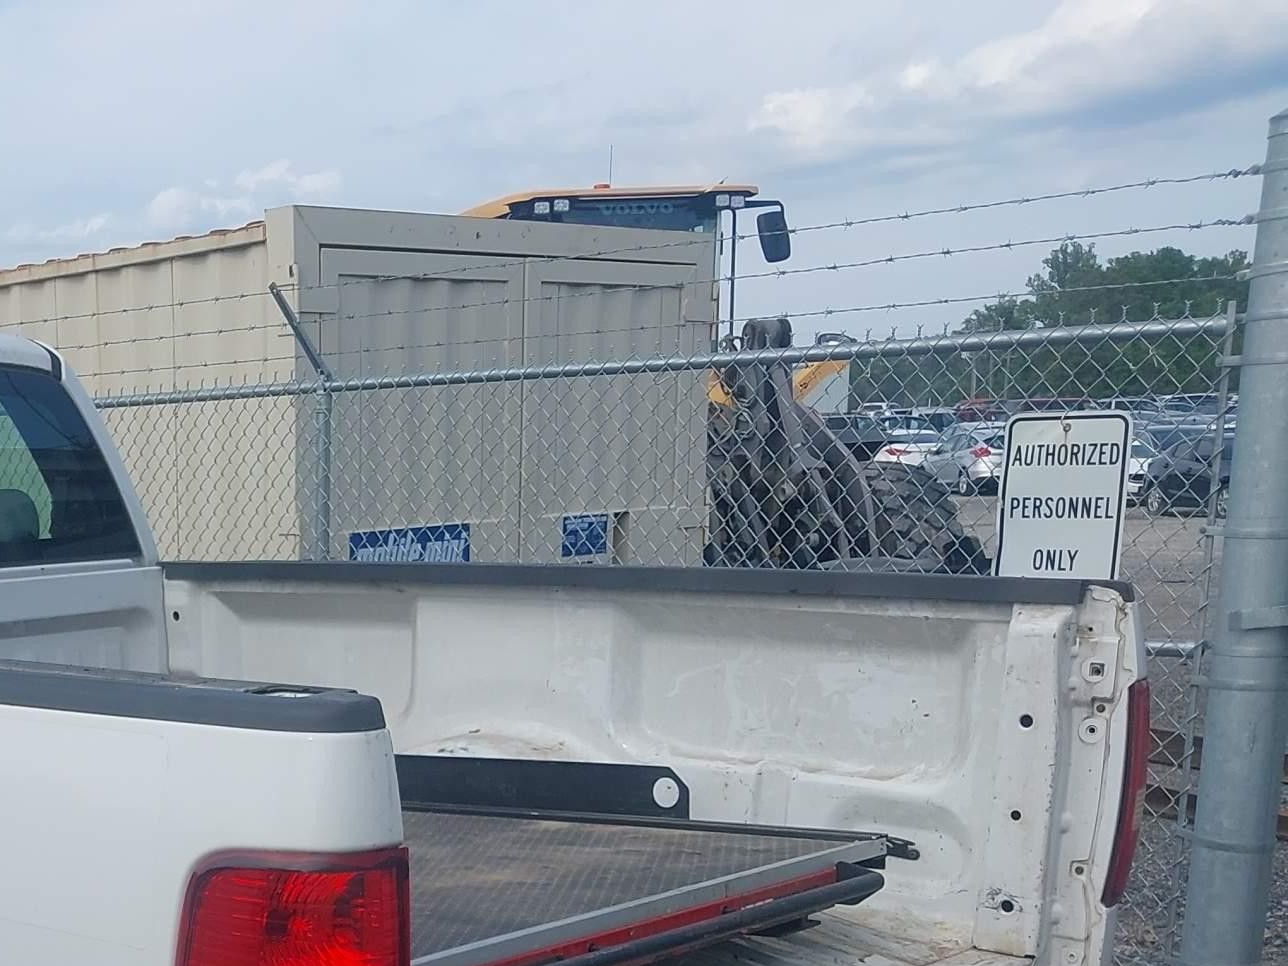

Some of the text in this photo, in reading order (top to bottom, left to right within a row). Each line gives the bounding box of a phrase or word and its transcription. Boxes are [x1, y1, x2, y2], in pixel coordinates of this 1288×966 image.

[600, 203, 673, 215] VOLVO
[1012, 443, 1121, 466] AUTHORIZED
[1010, 497, 1114, 518] PERSONNEL
[1033, 549, 1079, 571] ONLY
